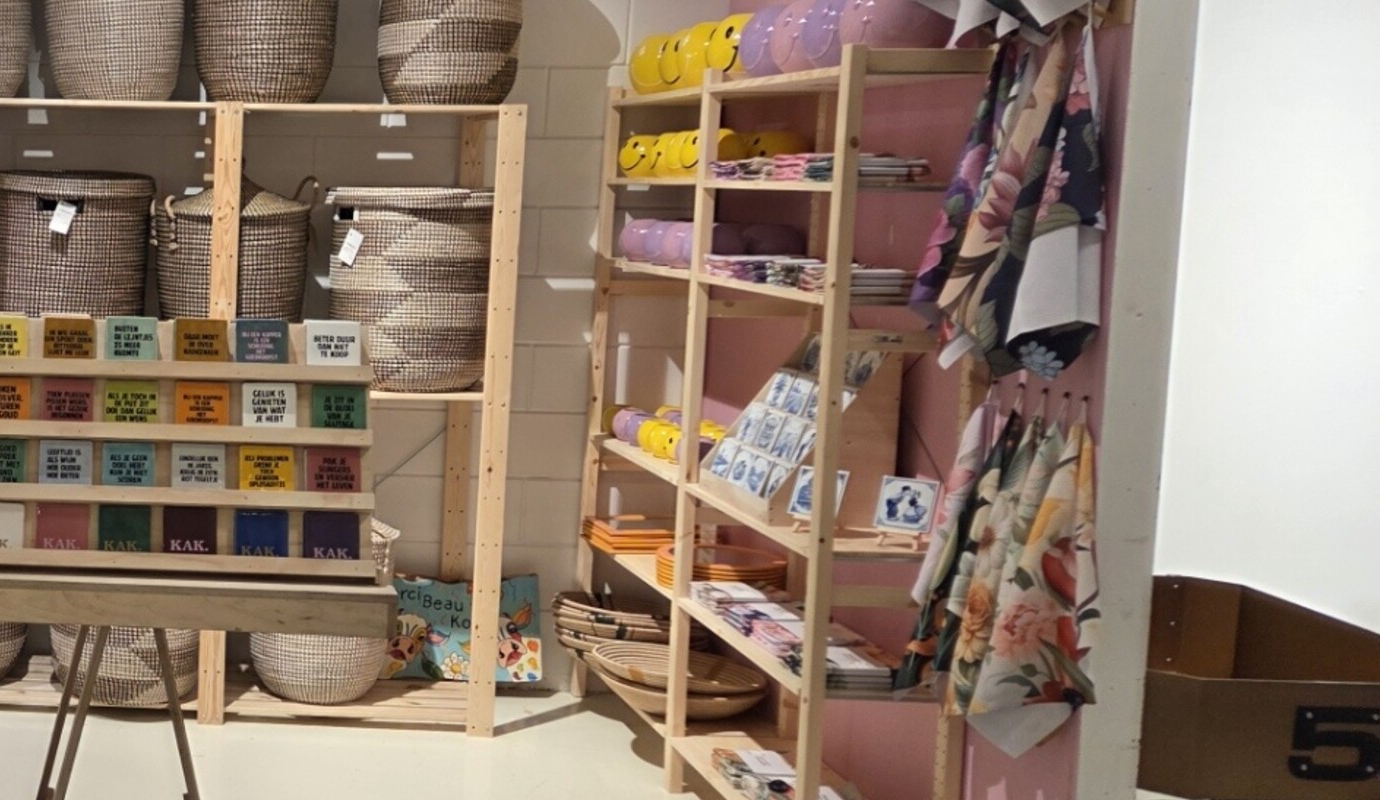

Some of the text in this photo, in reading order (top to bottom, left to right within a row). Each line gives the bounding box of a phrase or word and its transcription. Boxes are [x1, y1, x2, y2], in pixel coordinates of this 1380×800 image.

[170, 540, 209, 552] KAK.
[400, 587, 420, 601] rci
[423, 594, 464, 612] Beau
[451, 615, 471, 629] Ko
[1287, 704, 1380, 782] 5
